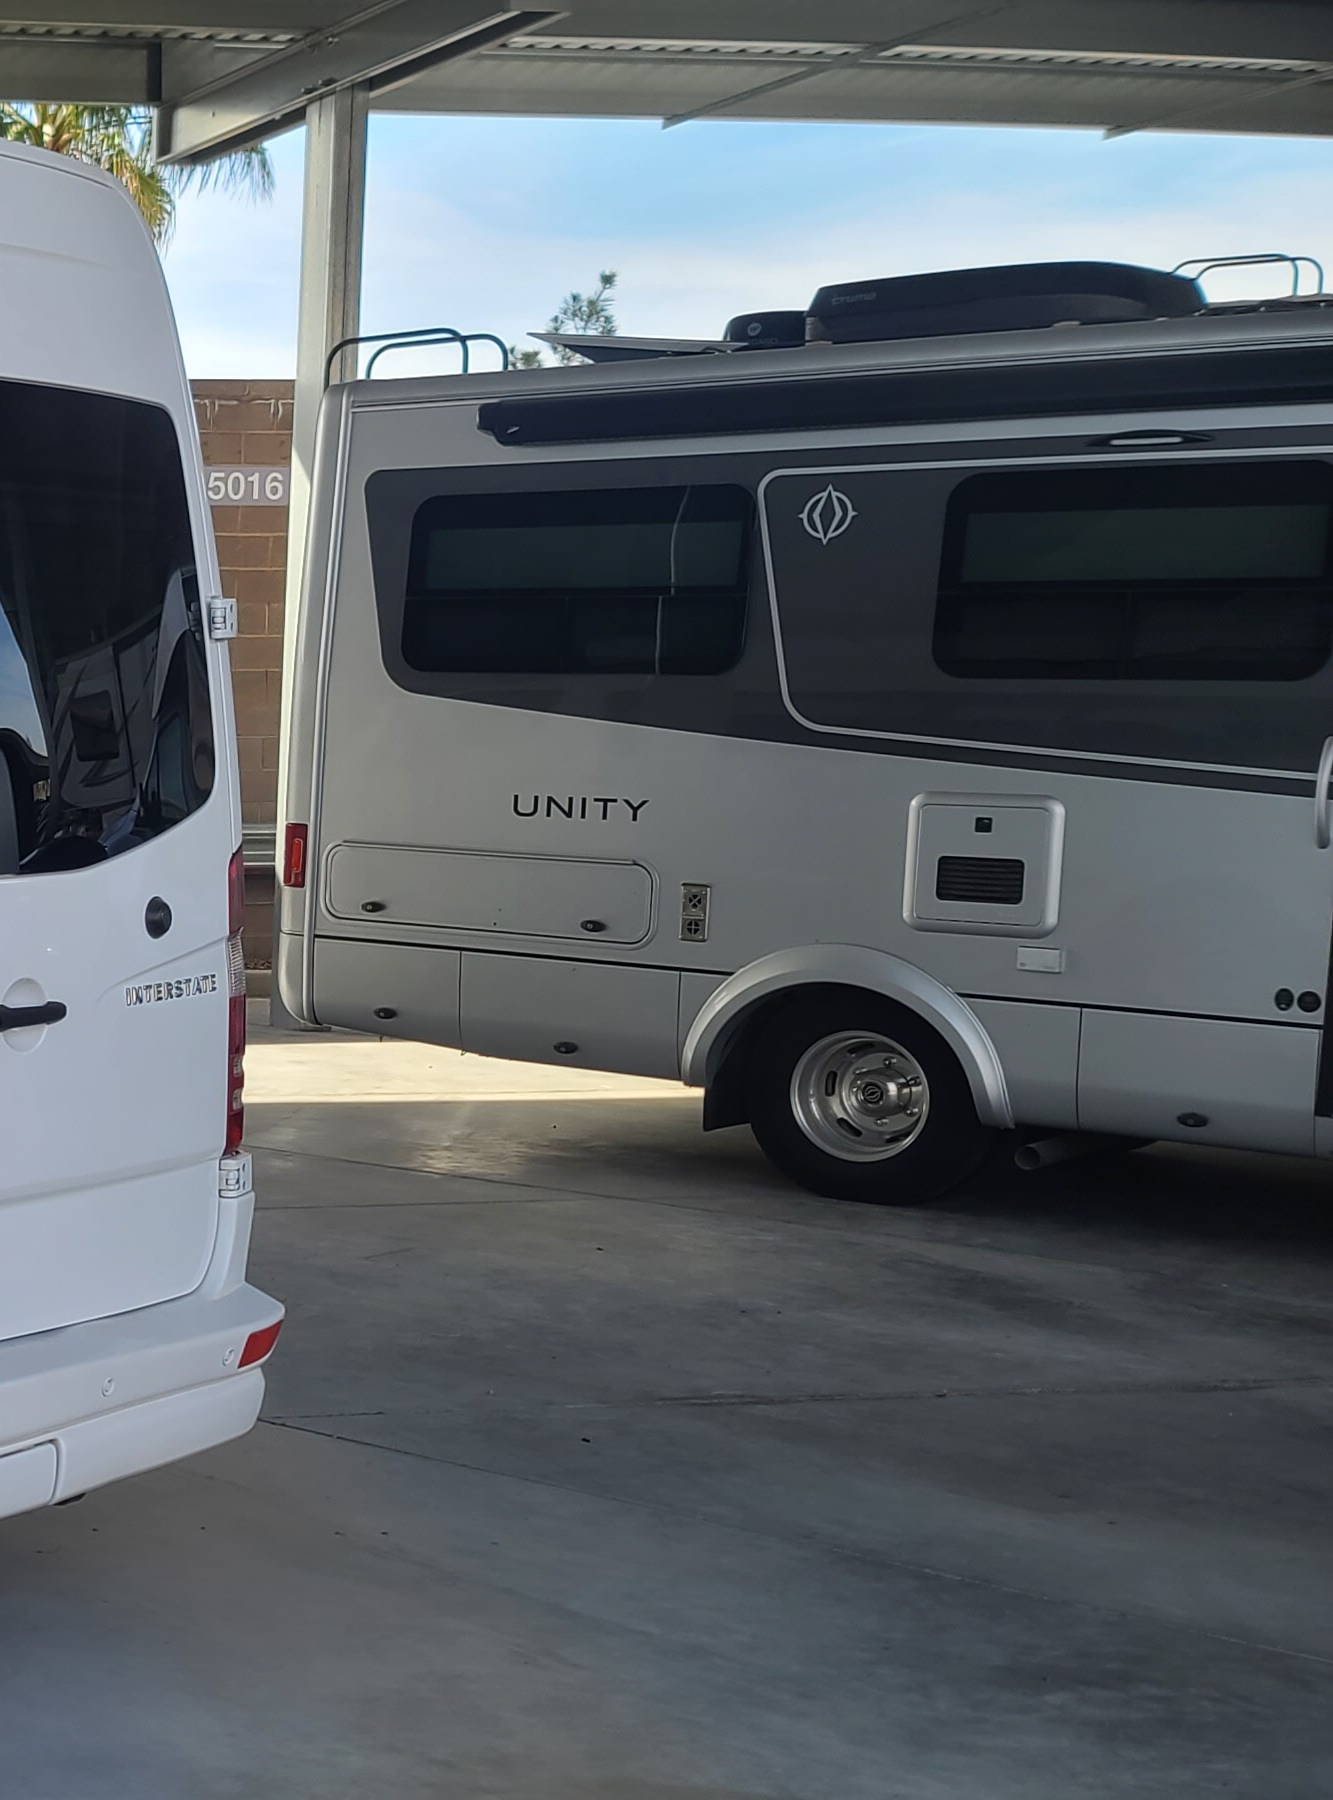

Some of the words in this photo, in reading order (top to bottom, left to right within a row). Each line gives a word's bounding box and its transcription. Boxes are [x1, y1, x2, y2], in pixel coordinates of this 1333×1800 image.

[207, 471, 283, 501] 5016
[513, 794, 650, 822] UNITY
[125, 973, 217, 1007] INTERSTATE
